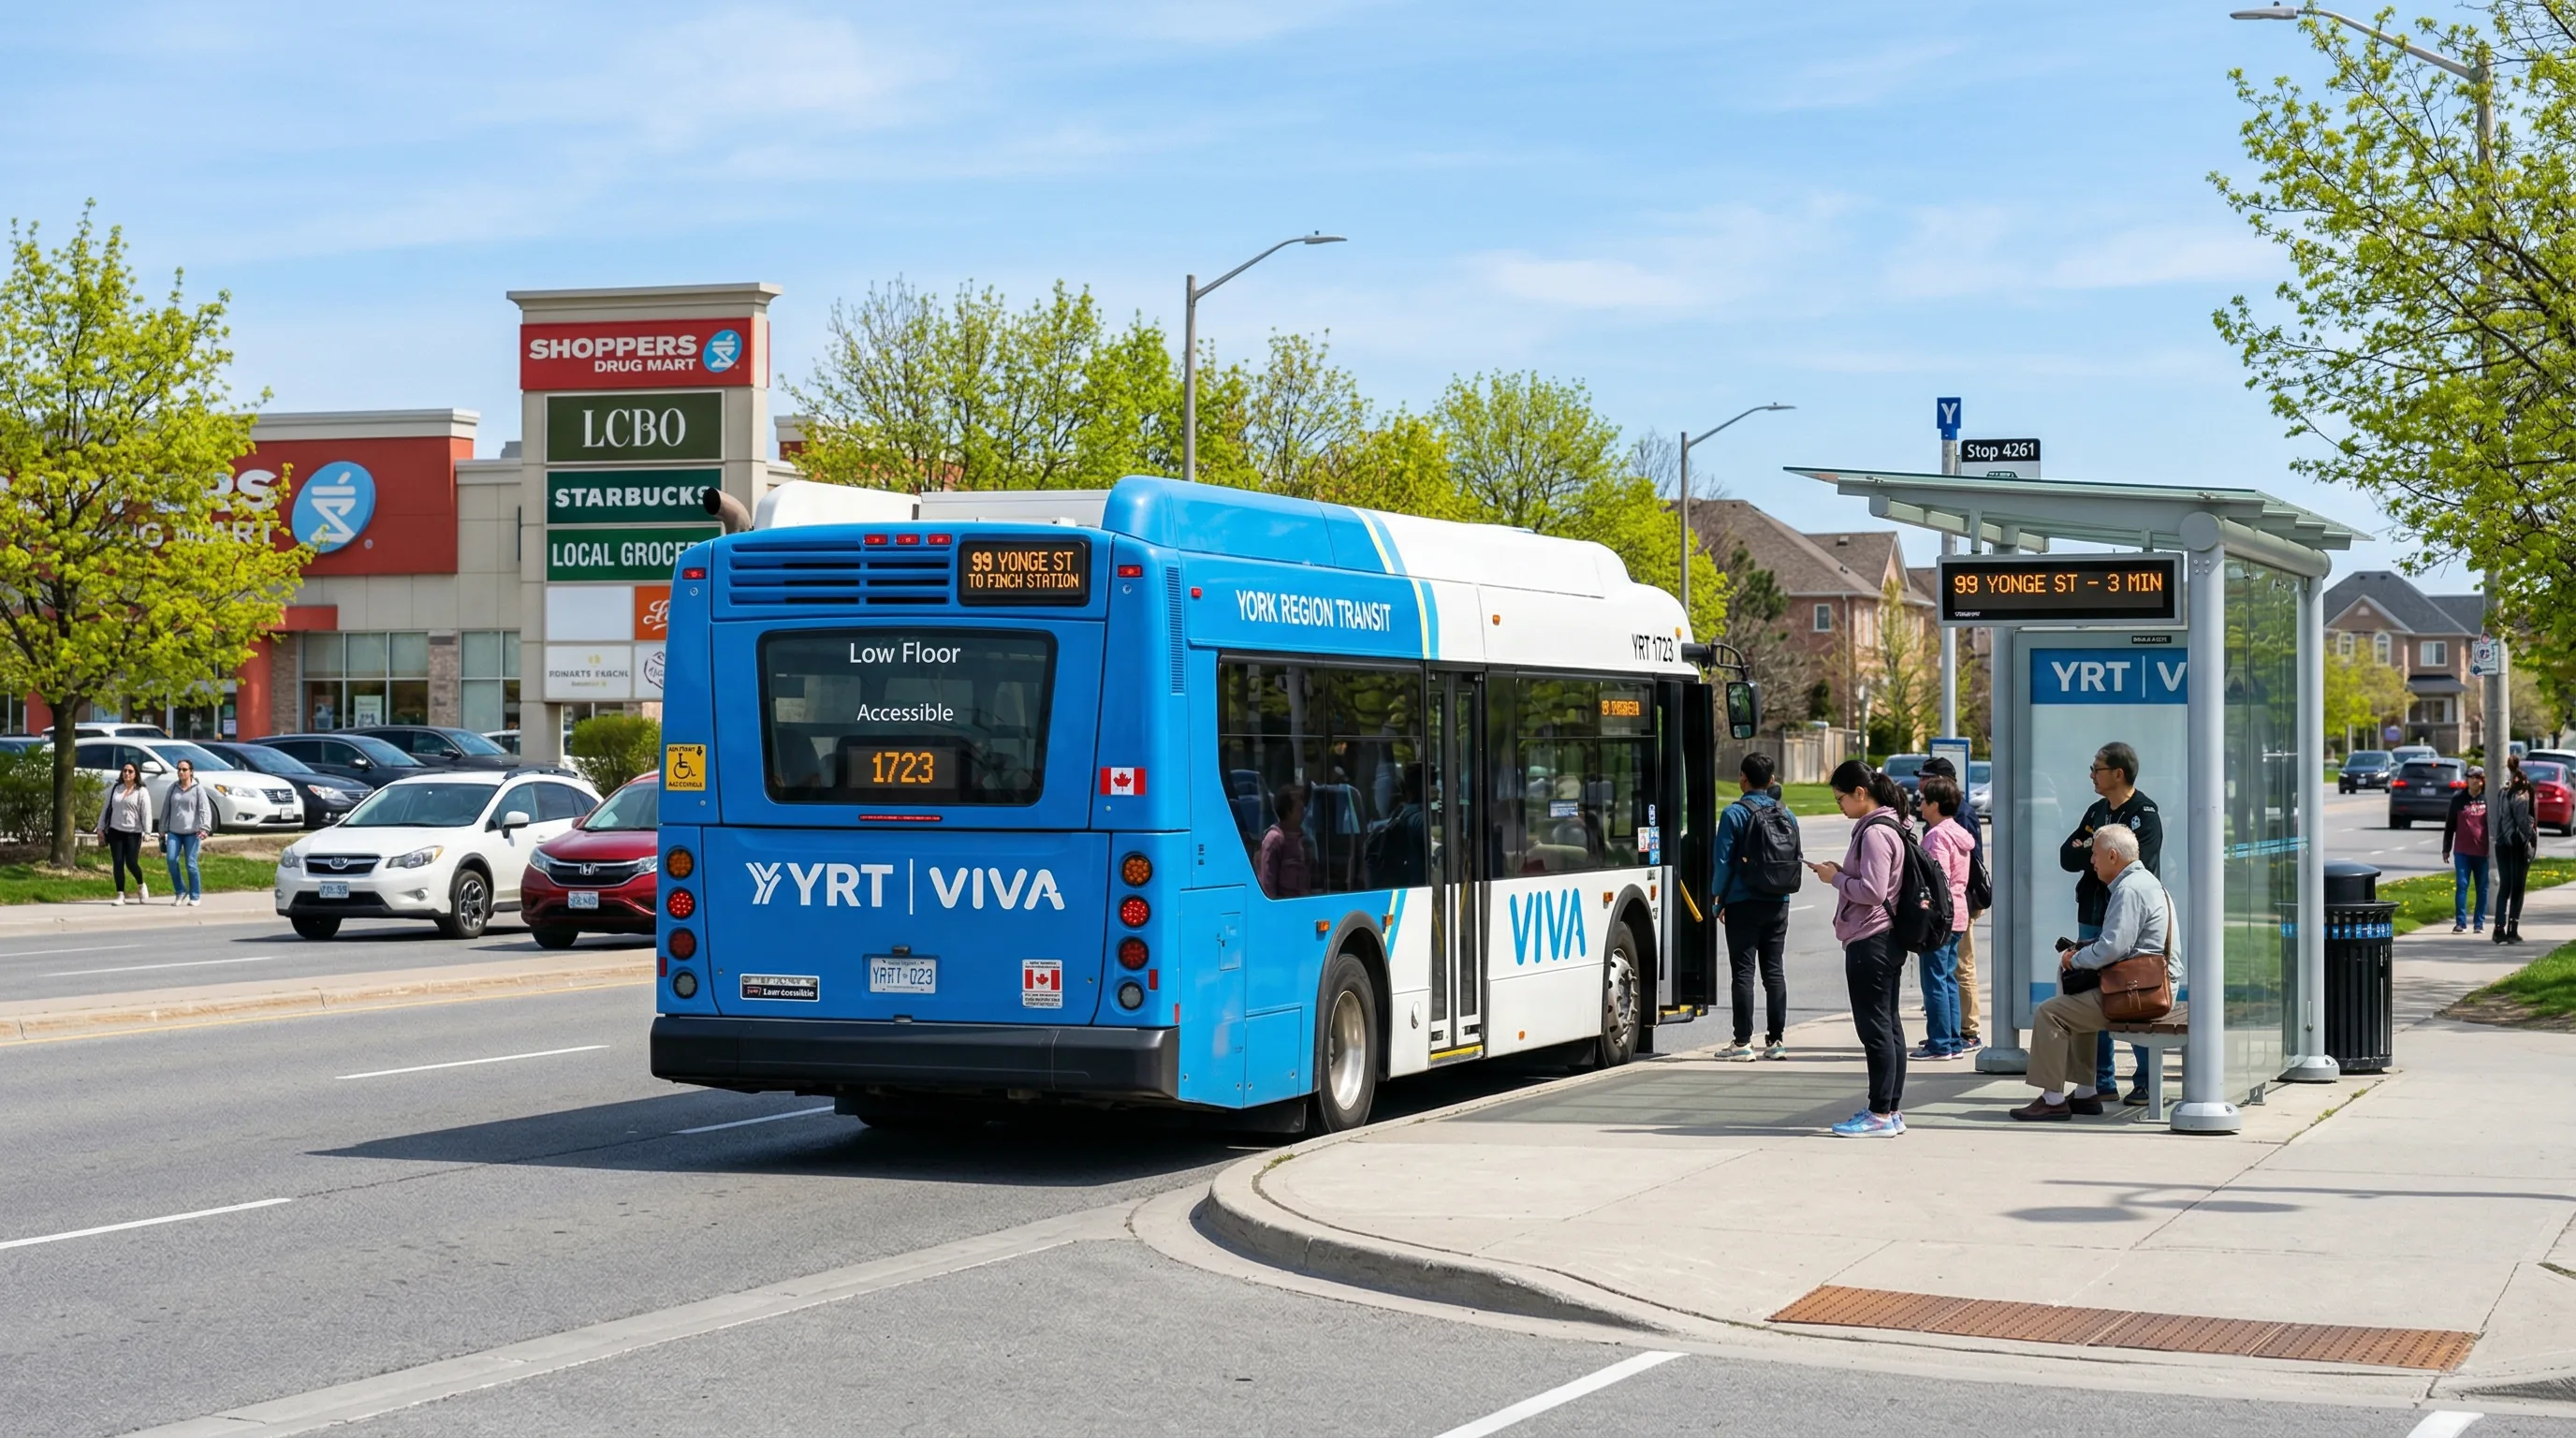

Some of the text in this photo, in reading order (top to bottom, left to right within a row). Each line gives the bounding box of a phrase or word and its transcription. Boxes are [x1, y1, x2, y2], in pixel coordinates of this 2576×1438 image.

[529, 335, 697, 360] SHOPPERS
[594, 359, 696, 373] DRUG MART
[1940, 403, 1958, 424] Y
[582, 407, 686, 448] LCBO
[1968, 443, 2034, 462] Stop 4261
[552, 542, 698, 566] LOCAL GROCE
[972, 551, 1074, 572] 99 YONGE ST
[968, 574, 1078, 588] TO FINCH STATION
[1954, 575, 1979, 594] 99
[1987, 574, 2046, 594] YONGE
[2055, 574, 2078, 593] ST
[2107, 573, 2120, 592] 3
[2128, 573, 2162, 592] MIN
[1236, 590, 1391, 632] YORK REGION TRANSIT
[850, 641, 960, 663] Low Floor
[1632, 633, 1674, 662] YRT 1723
[2051, 661, 2130, 692] YRT
[856, 703, 954, 721] Accessible
[872, 752, 934, 783] 1723
[786, 862, 893, 907] YRT
[929, 867, 1065, 910] VIVA
[1510, 888, 1586, 965] VIVA
